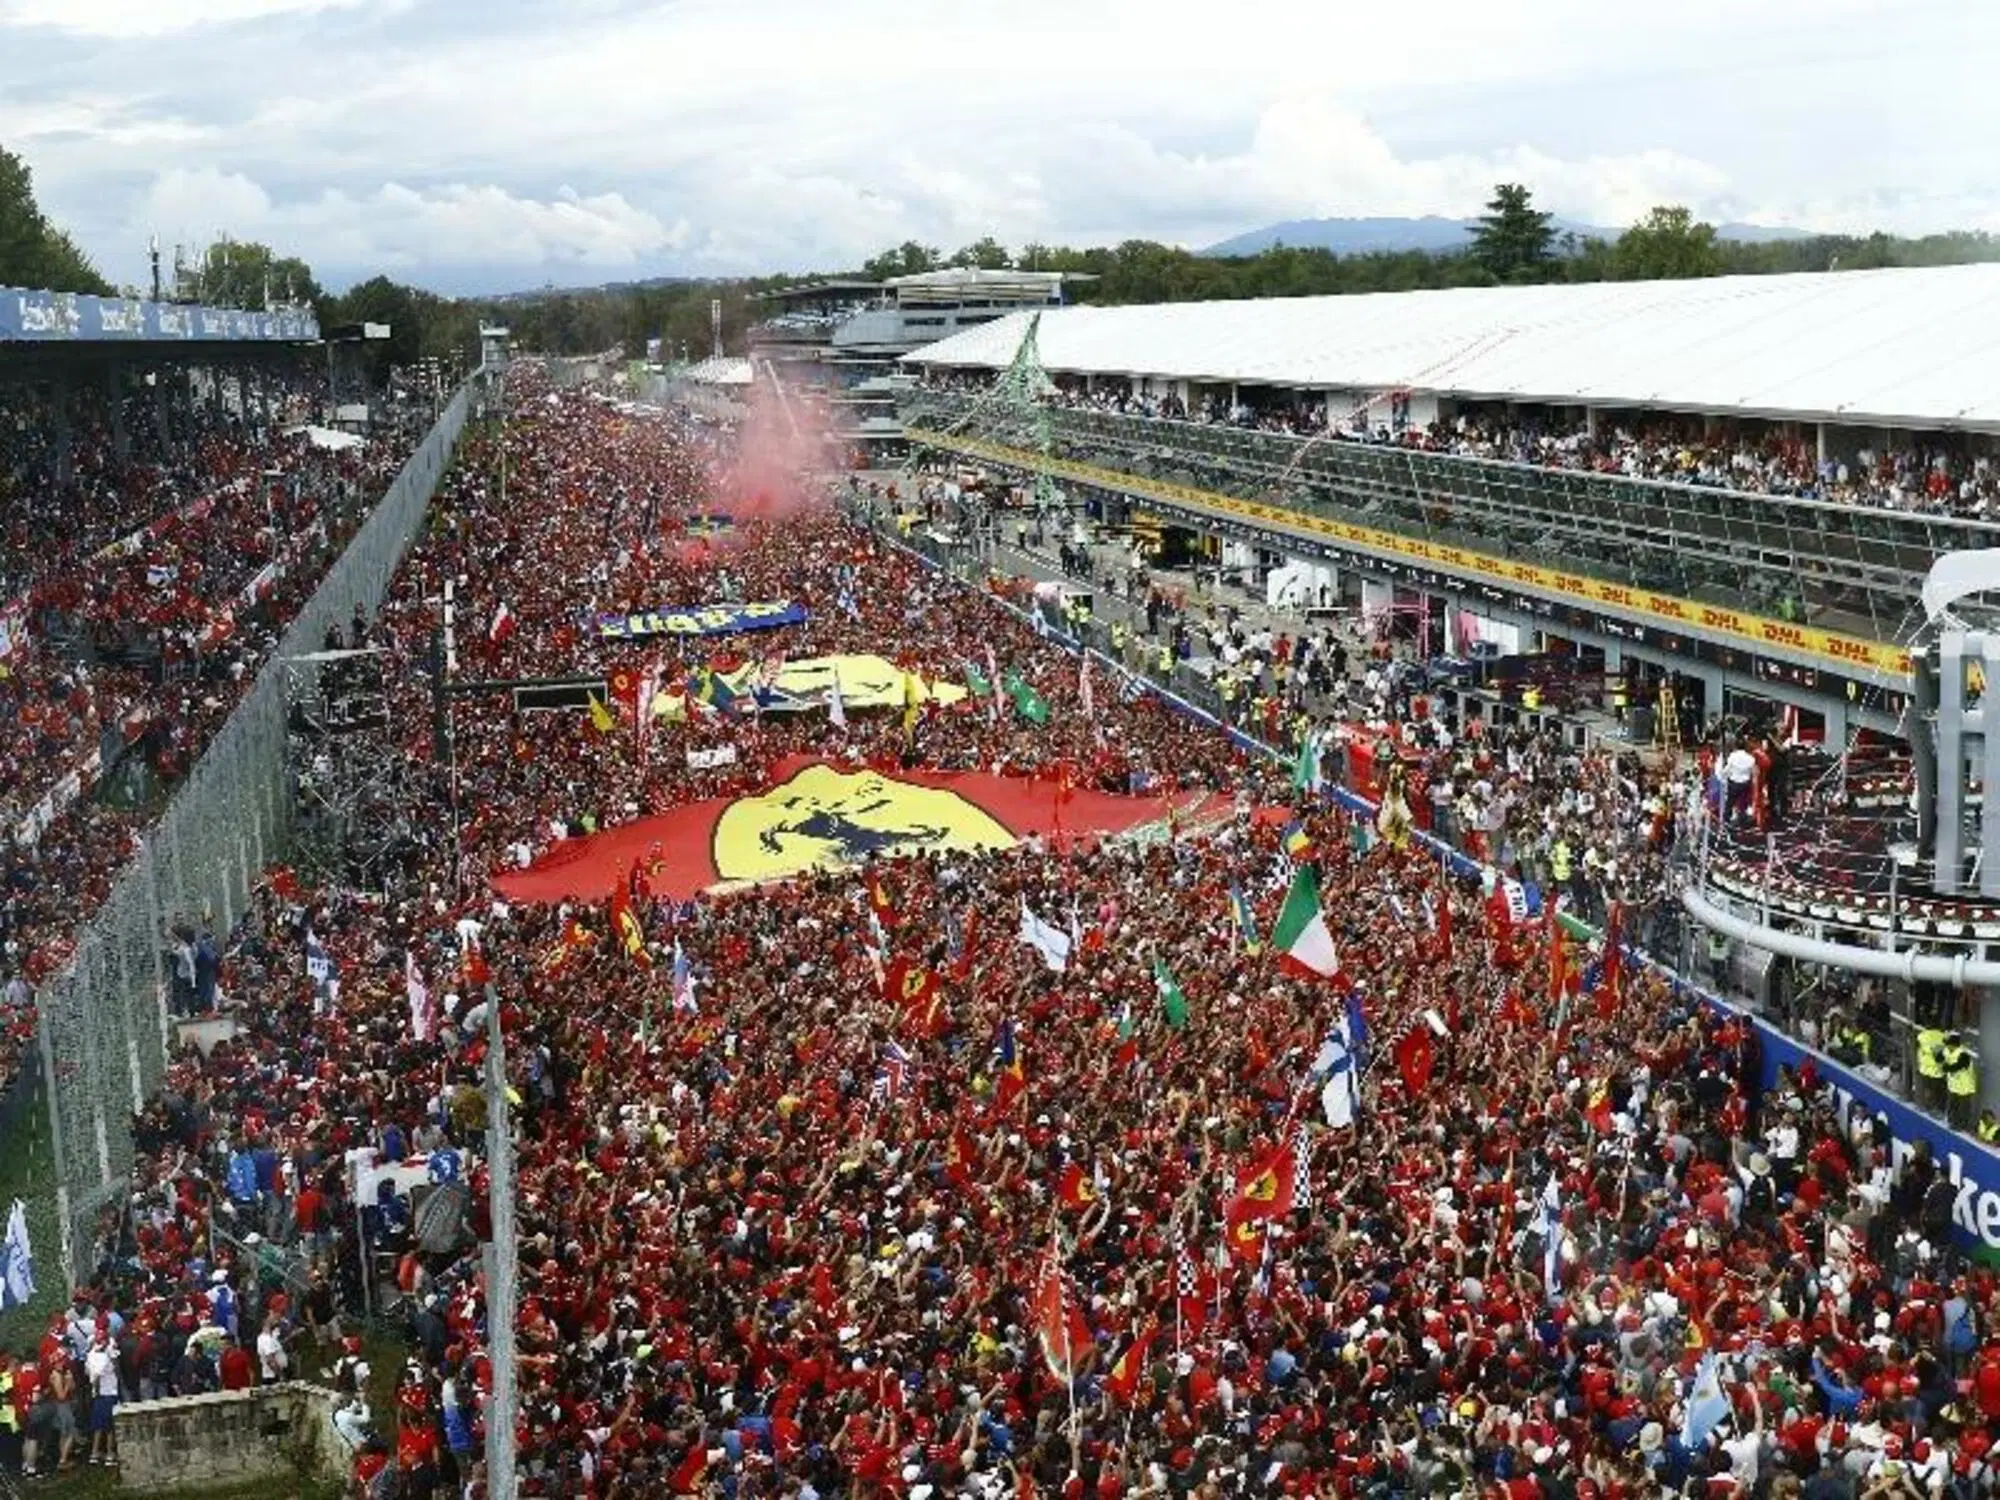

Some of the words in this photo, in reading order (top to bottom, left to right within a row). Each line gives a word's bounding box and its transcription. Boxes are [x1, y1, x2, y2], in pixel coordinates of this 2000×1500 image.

[1702, 608, 1744, 631] DHL
[1763, 622, 1806, 648] DHL
[1827, 637, 1874, 664] DHL
